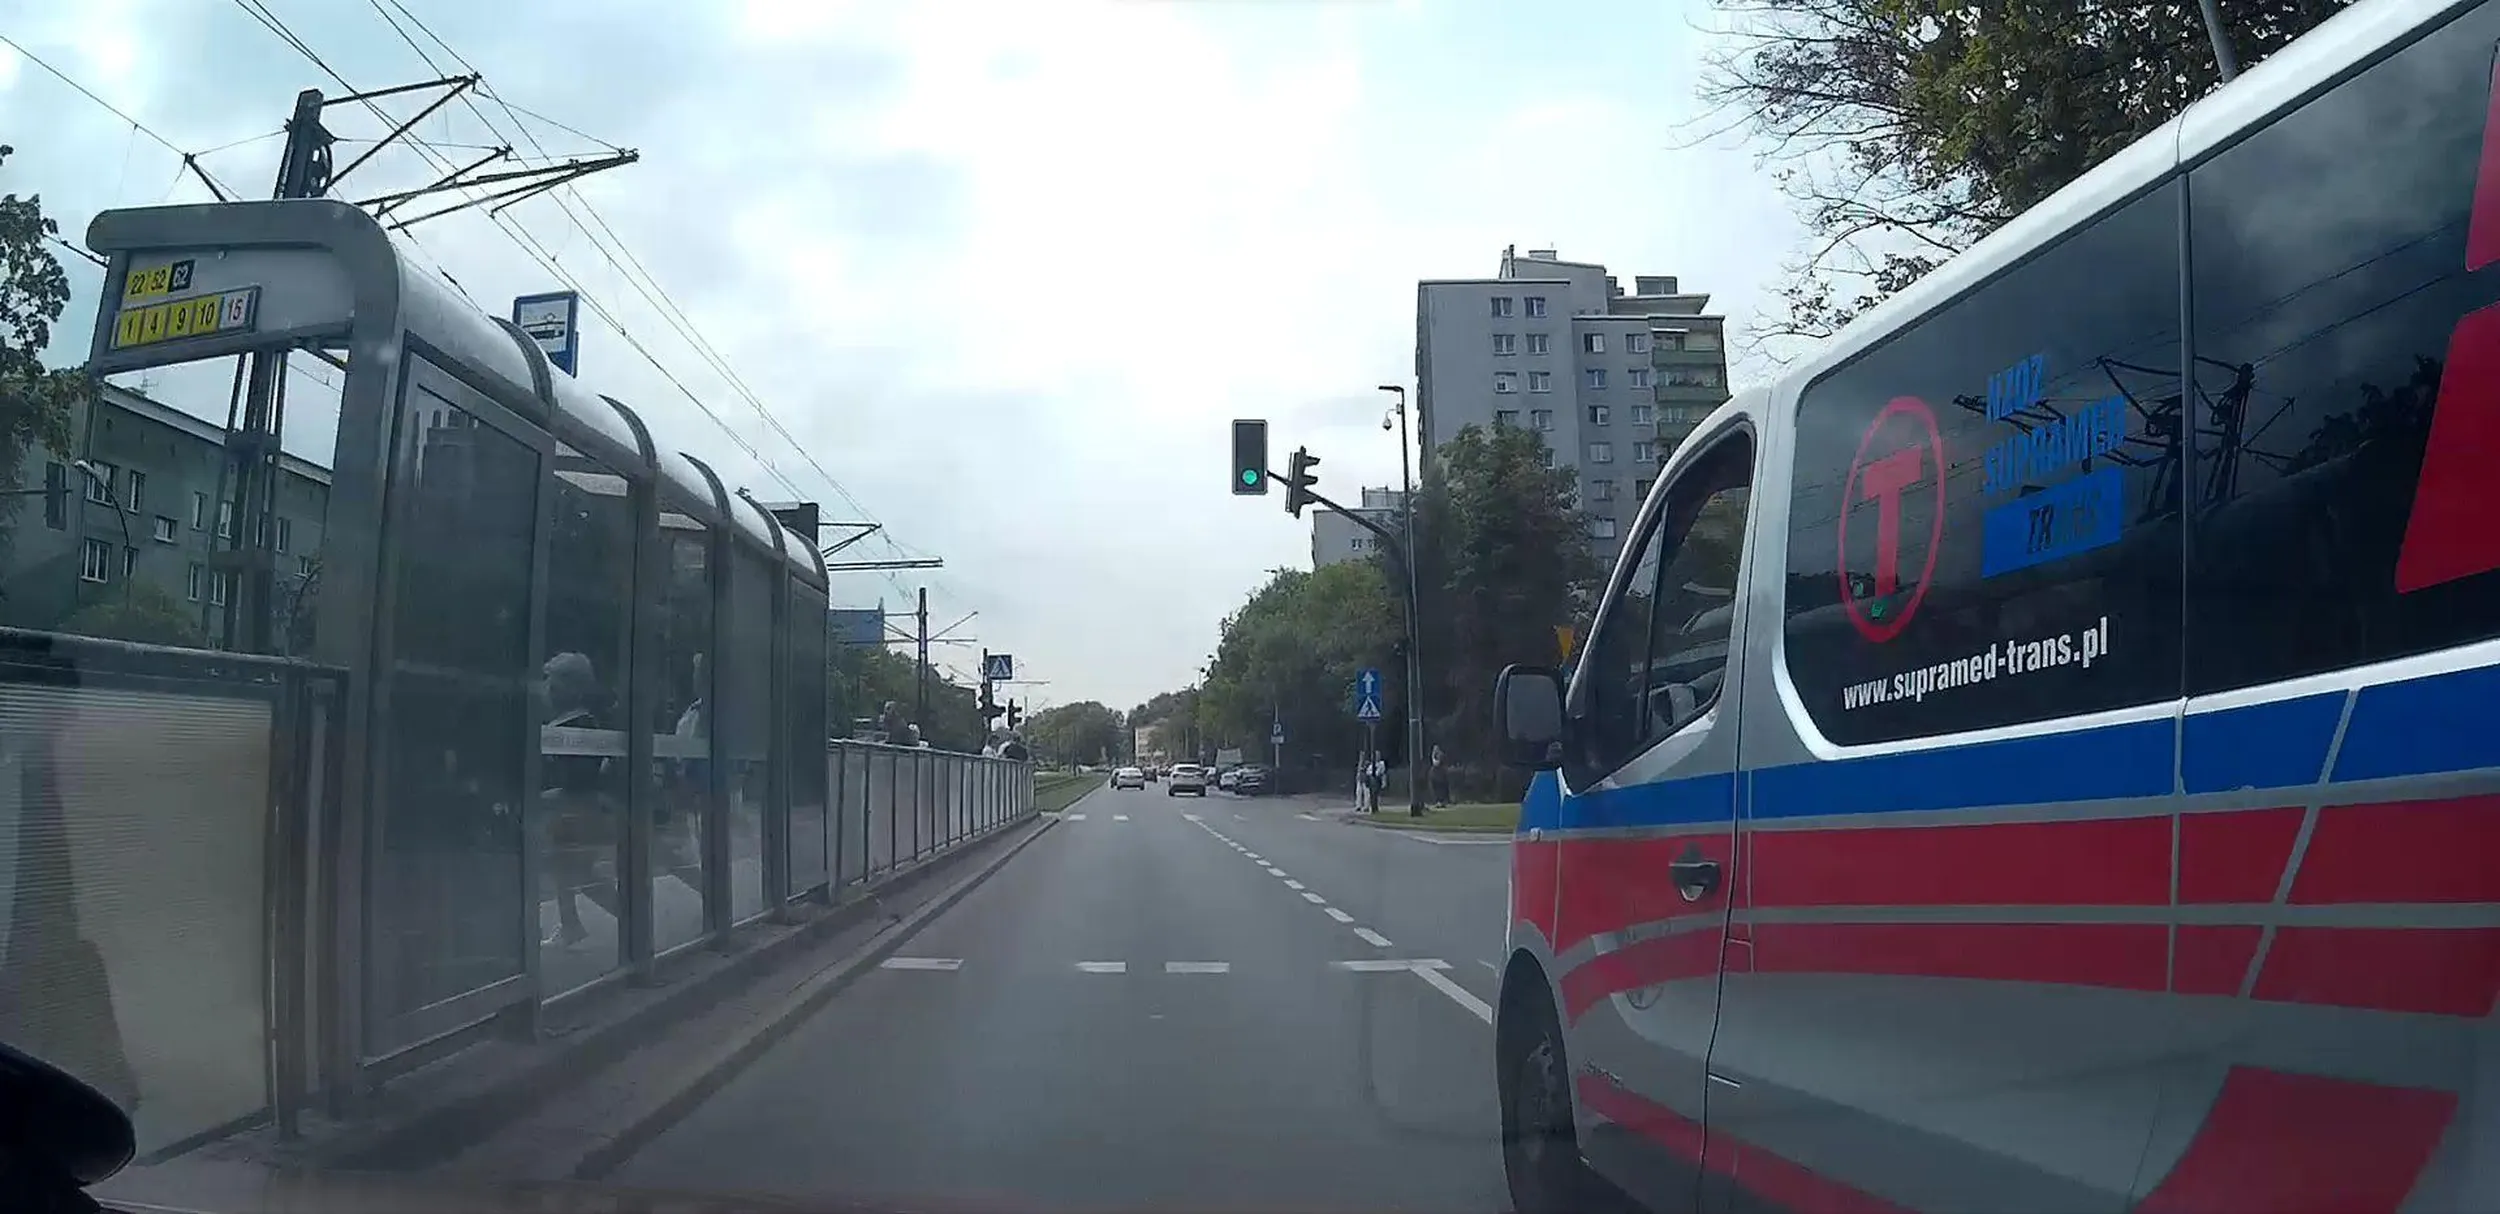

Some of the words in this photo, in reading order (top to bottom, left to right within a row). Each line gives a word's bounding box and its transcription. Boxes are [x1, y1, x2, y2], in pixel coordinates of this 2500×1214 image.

[130, 273, 146, 295] 22
[151, 269, 167, 291] 52
[173, 265, 189, 288] 62
[150, 312, 159, 334] 4
[176, 307, 187, 331] 9
[200, 301, 216, 326] 10
[1843, 616, 2108, 710] www.supramed-trans.pl
